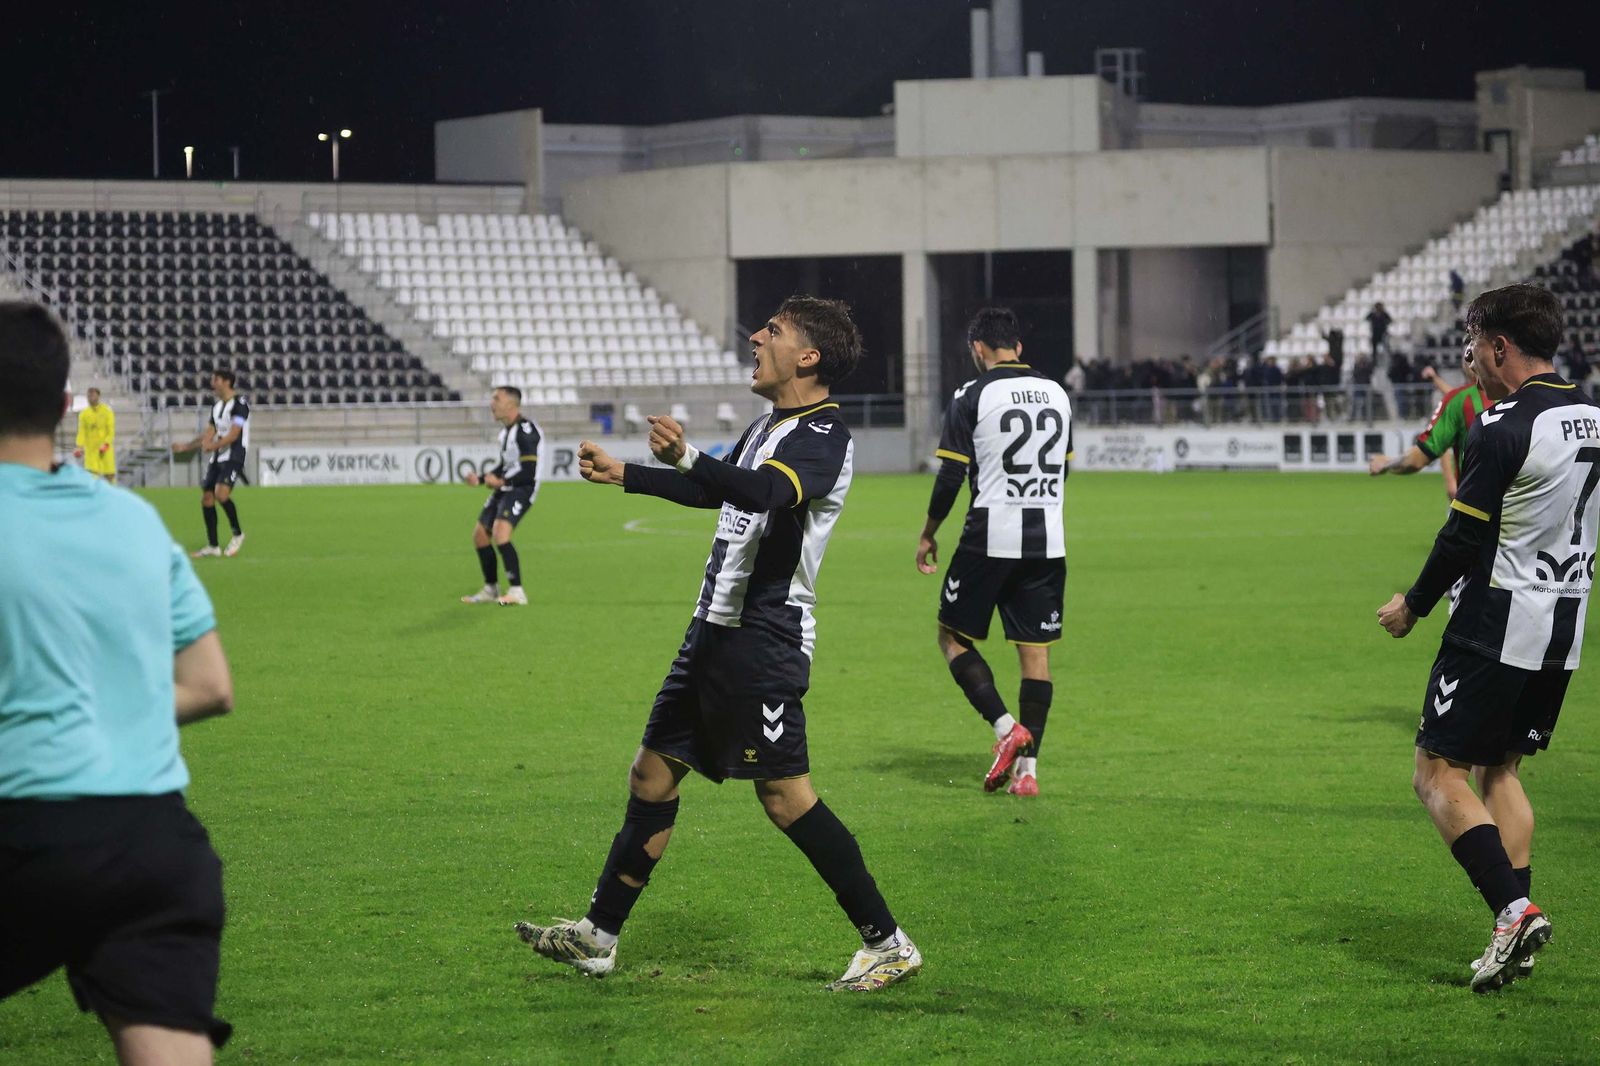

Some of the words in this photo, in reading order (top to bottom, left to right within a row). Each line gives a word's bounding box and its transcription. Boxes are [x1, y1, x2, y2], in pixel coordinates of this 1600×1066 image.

[1011, 391, 1050, 405] DIEGO
[1561, 418, 1600, 441] PEPE
[1000, 408, 1063, 475] 22
[290, 454, 321, 472] TOP
[327, 452, 400, 473] VERTICAL
[1570, 446, 1600, 546] 7
